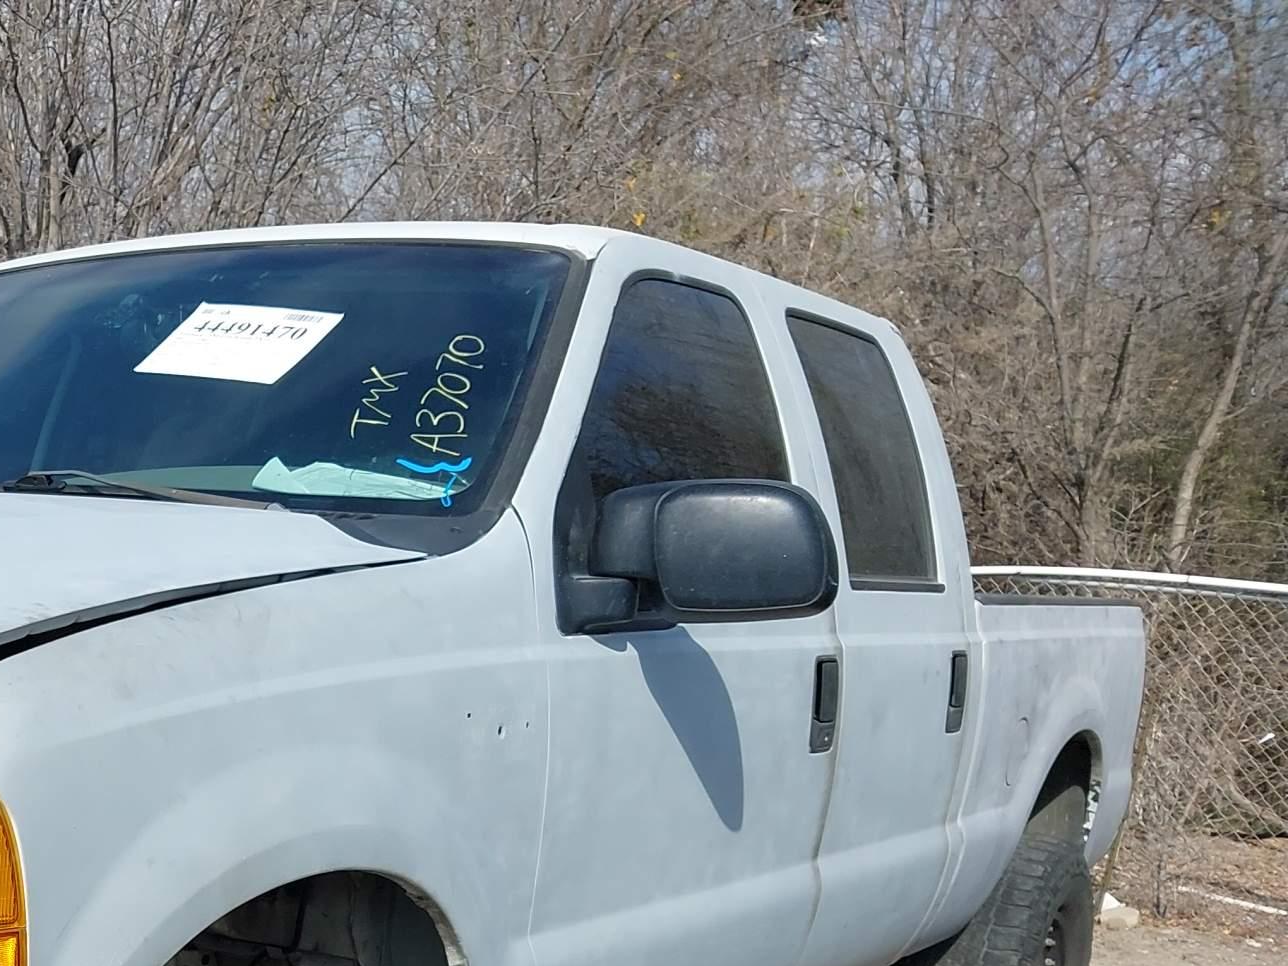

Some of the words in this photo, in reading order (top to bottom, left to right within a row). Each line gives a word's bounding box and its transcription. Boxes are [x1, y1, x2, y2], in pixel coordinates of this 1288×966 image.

[193, 319, 309, 341] 44491470
[350, 366, 409, 439] TMX
[410, 334, 486, 456] A37070
